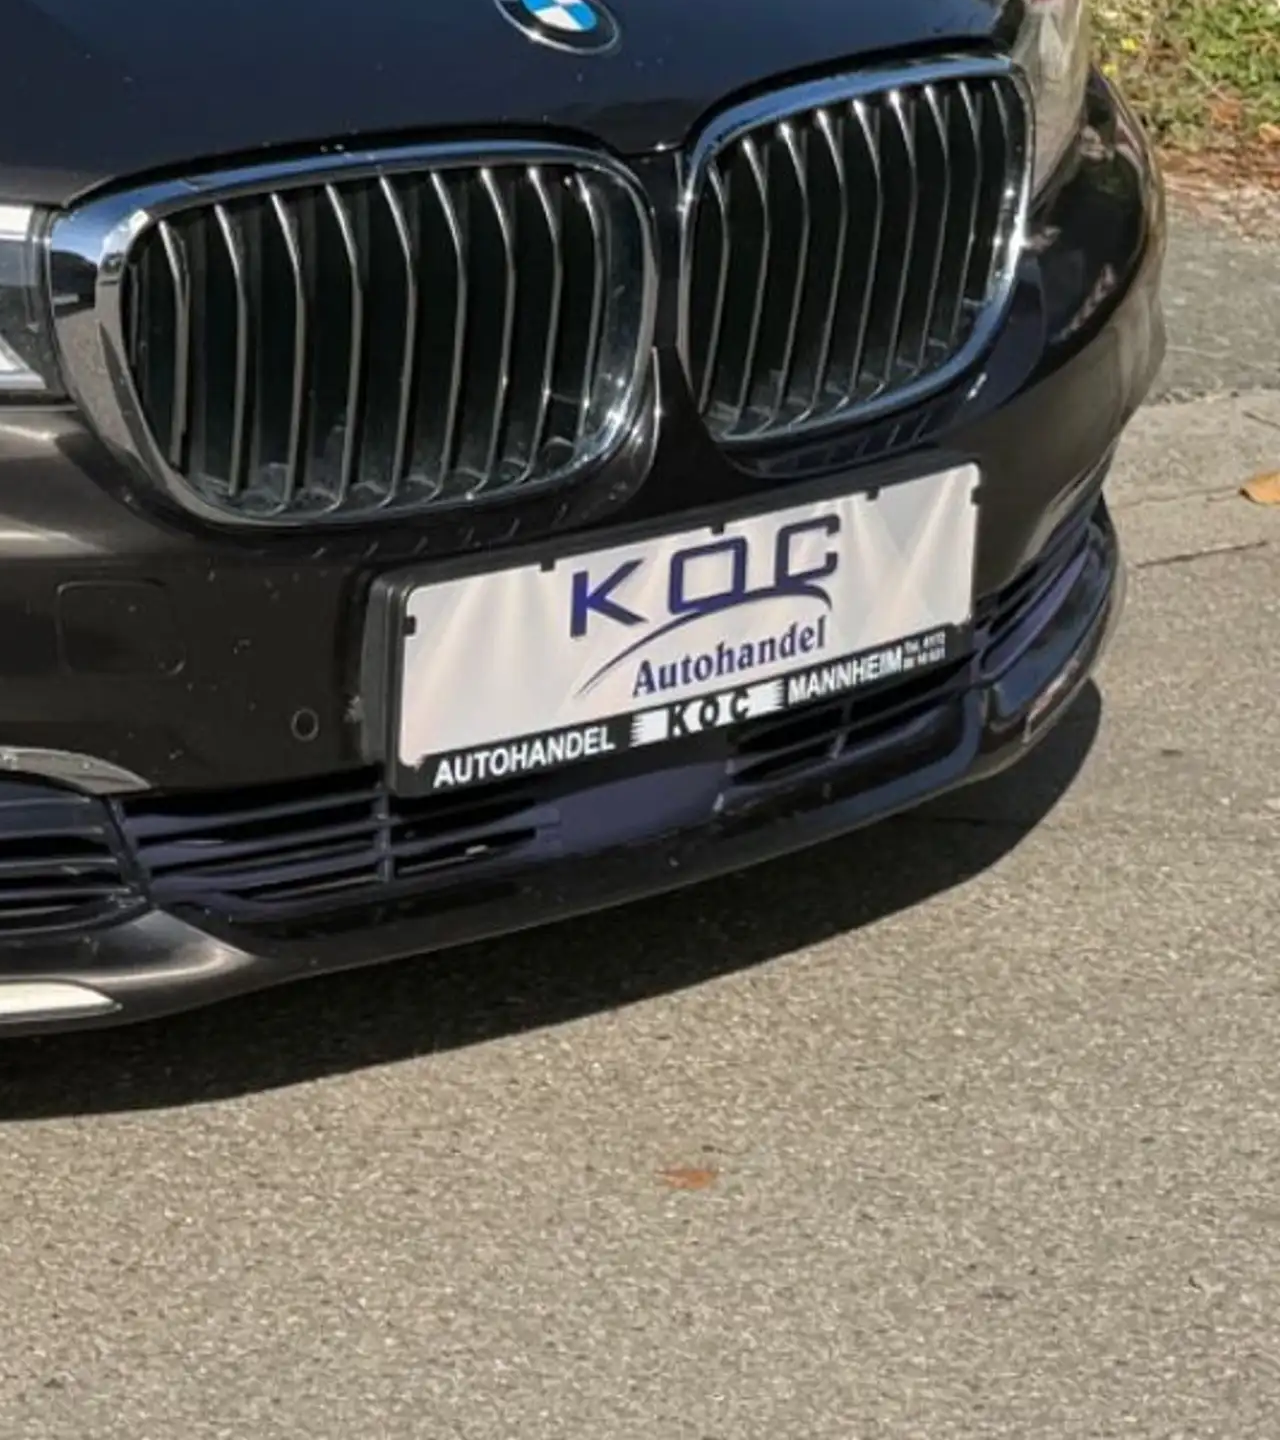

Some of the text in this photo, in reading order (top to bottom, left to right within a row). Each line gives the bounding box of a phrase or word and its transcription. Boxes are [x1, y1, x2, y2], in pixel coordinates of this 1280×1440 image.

[631, 614, 827, 698] Autohandel
[433, 644, 904, 789] AUTOHANDEL KOC MANNHEIM
